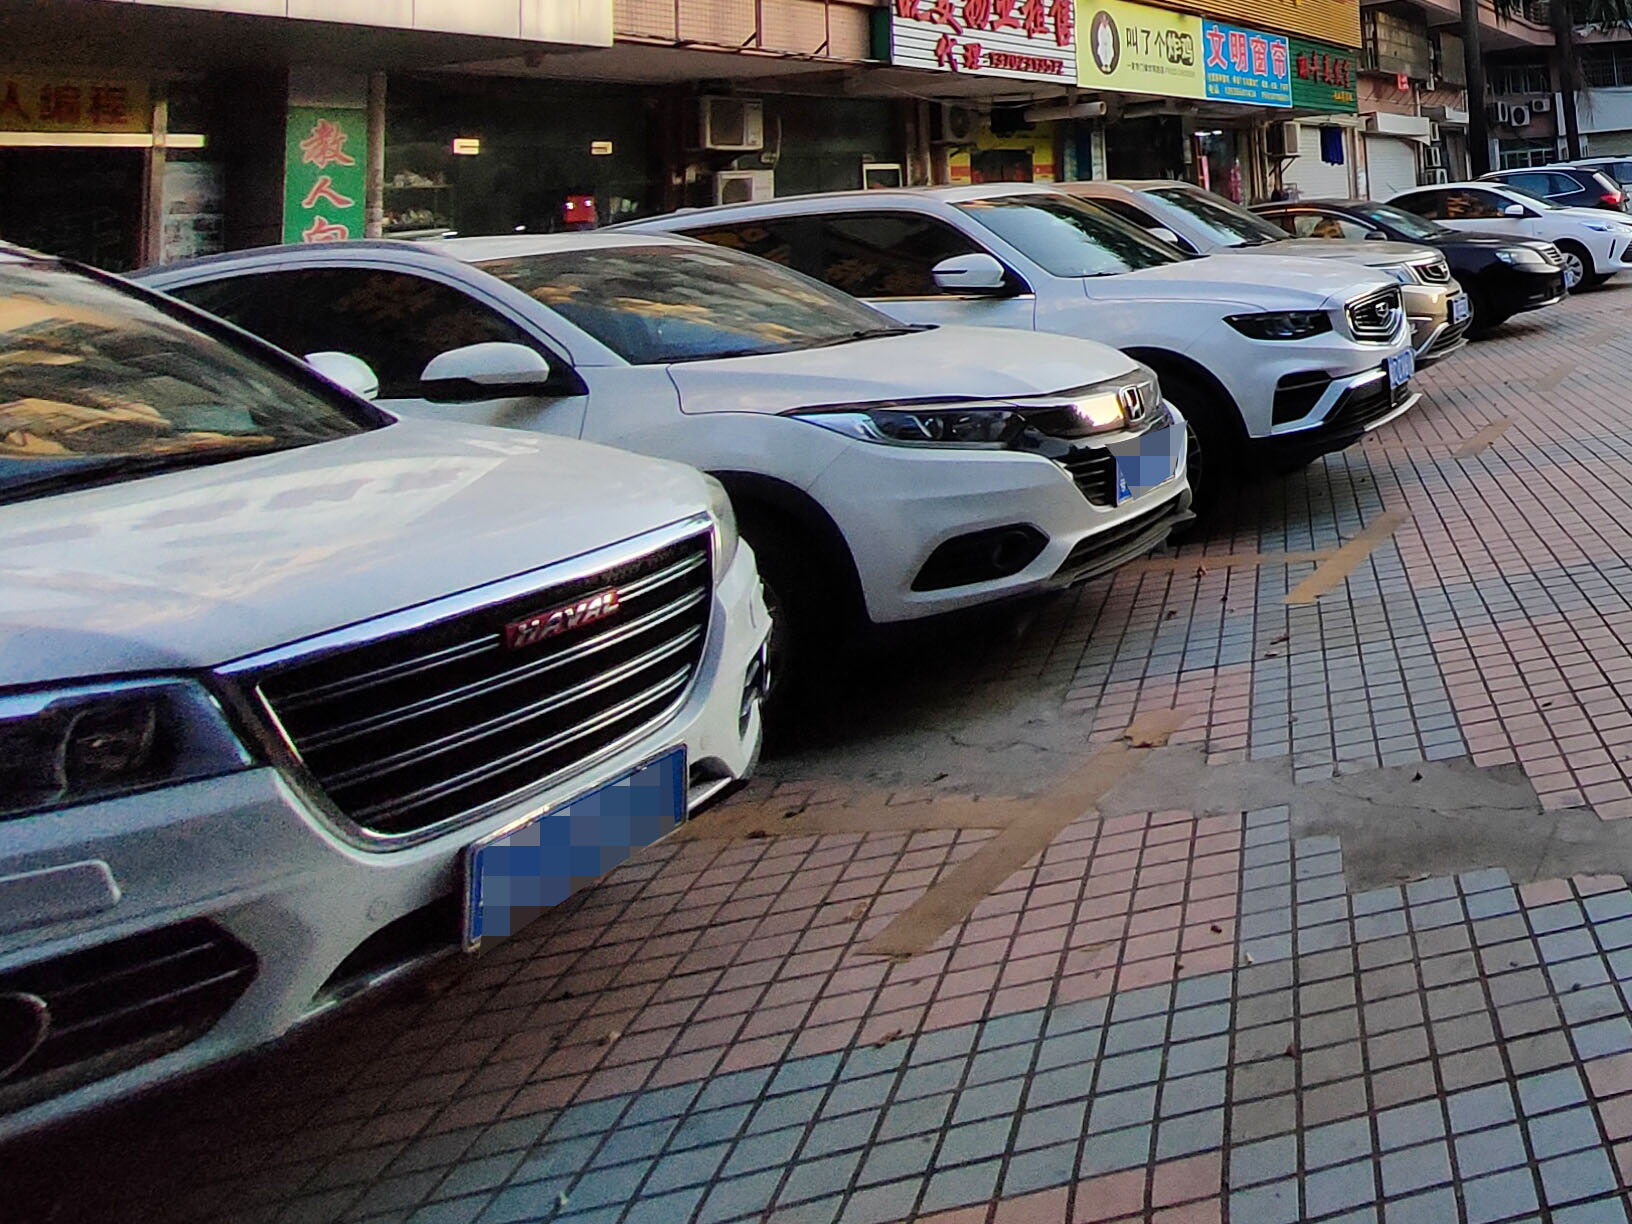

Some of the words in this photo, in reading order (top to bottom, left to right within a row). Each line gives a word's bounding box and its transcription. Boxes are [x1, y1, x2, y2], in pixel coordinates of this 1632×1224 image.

[1126, 26, 1194, 67] 叫了个炸鸡
[1207, 25, 1286, 79] 文明窗帘
[513, 593, 620, 648] HAVAL
